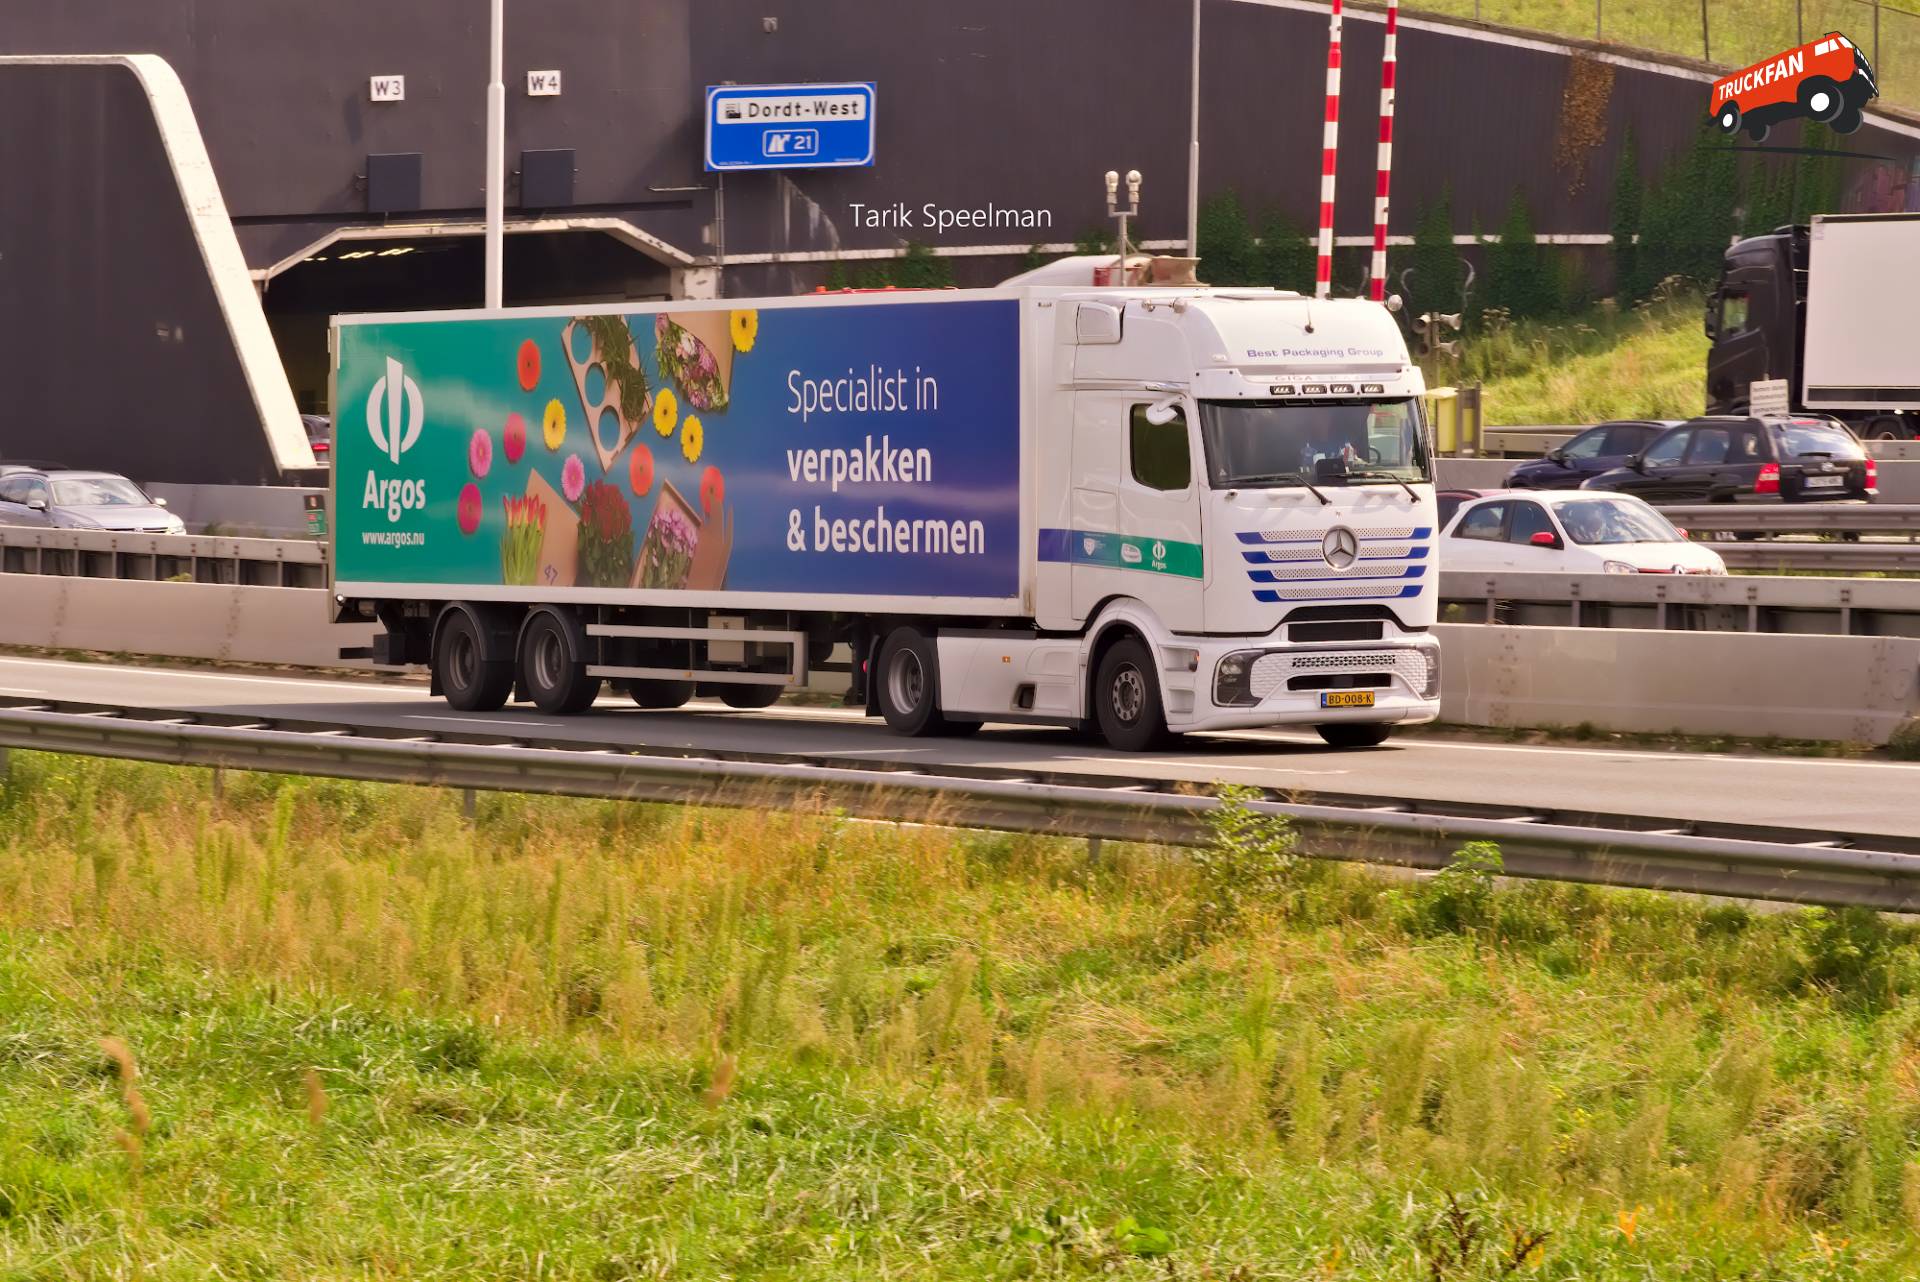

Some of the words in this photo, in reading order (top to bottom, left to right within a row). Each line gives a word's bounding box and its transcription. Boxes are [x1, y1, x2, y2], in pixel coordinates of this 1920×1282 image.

[748, 101, 858, 118] Dordt-West
[793, 135, 812, 150] 21
[1247, 349, 1279, 358] Best
[1282, 347, 1344, 358] Packaging
[1347, 347, 1384, 357] Group
[787, 364, 908, 423] Specialist
[916, 366, 938, 411] in
[787, 435, 932, 493] verpakken
[362, 470, 426, 523] Argos
[787, 508, 807, 552] &
[814, 505, 985, 555] beschermen
[362, 531, 425, 549] www.argos.nu
[1151, 560, 1167, 571] Argos
